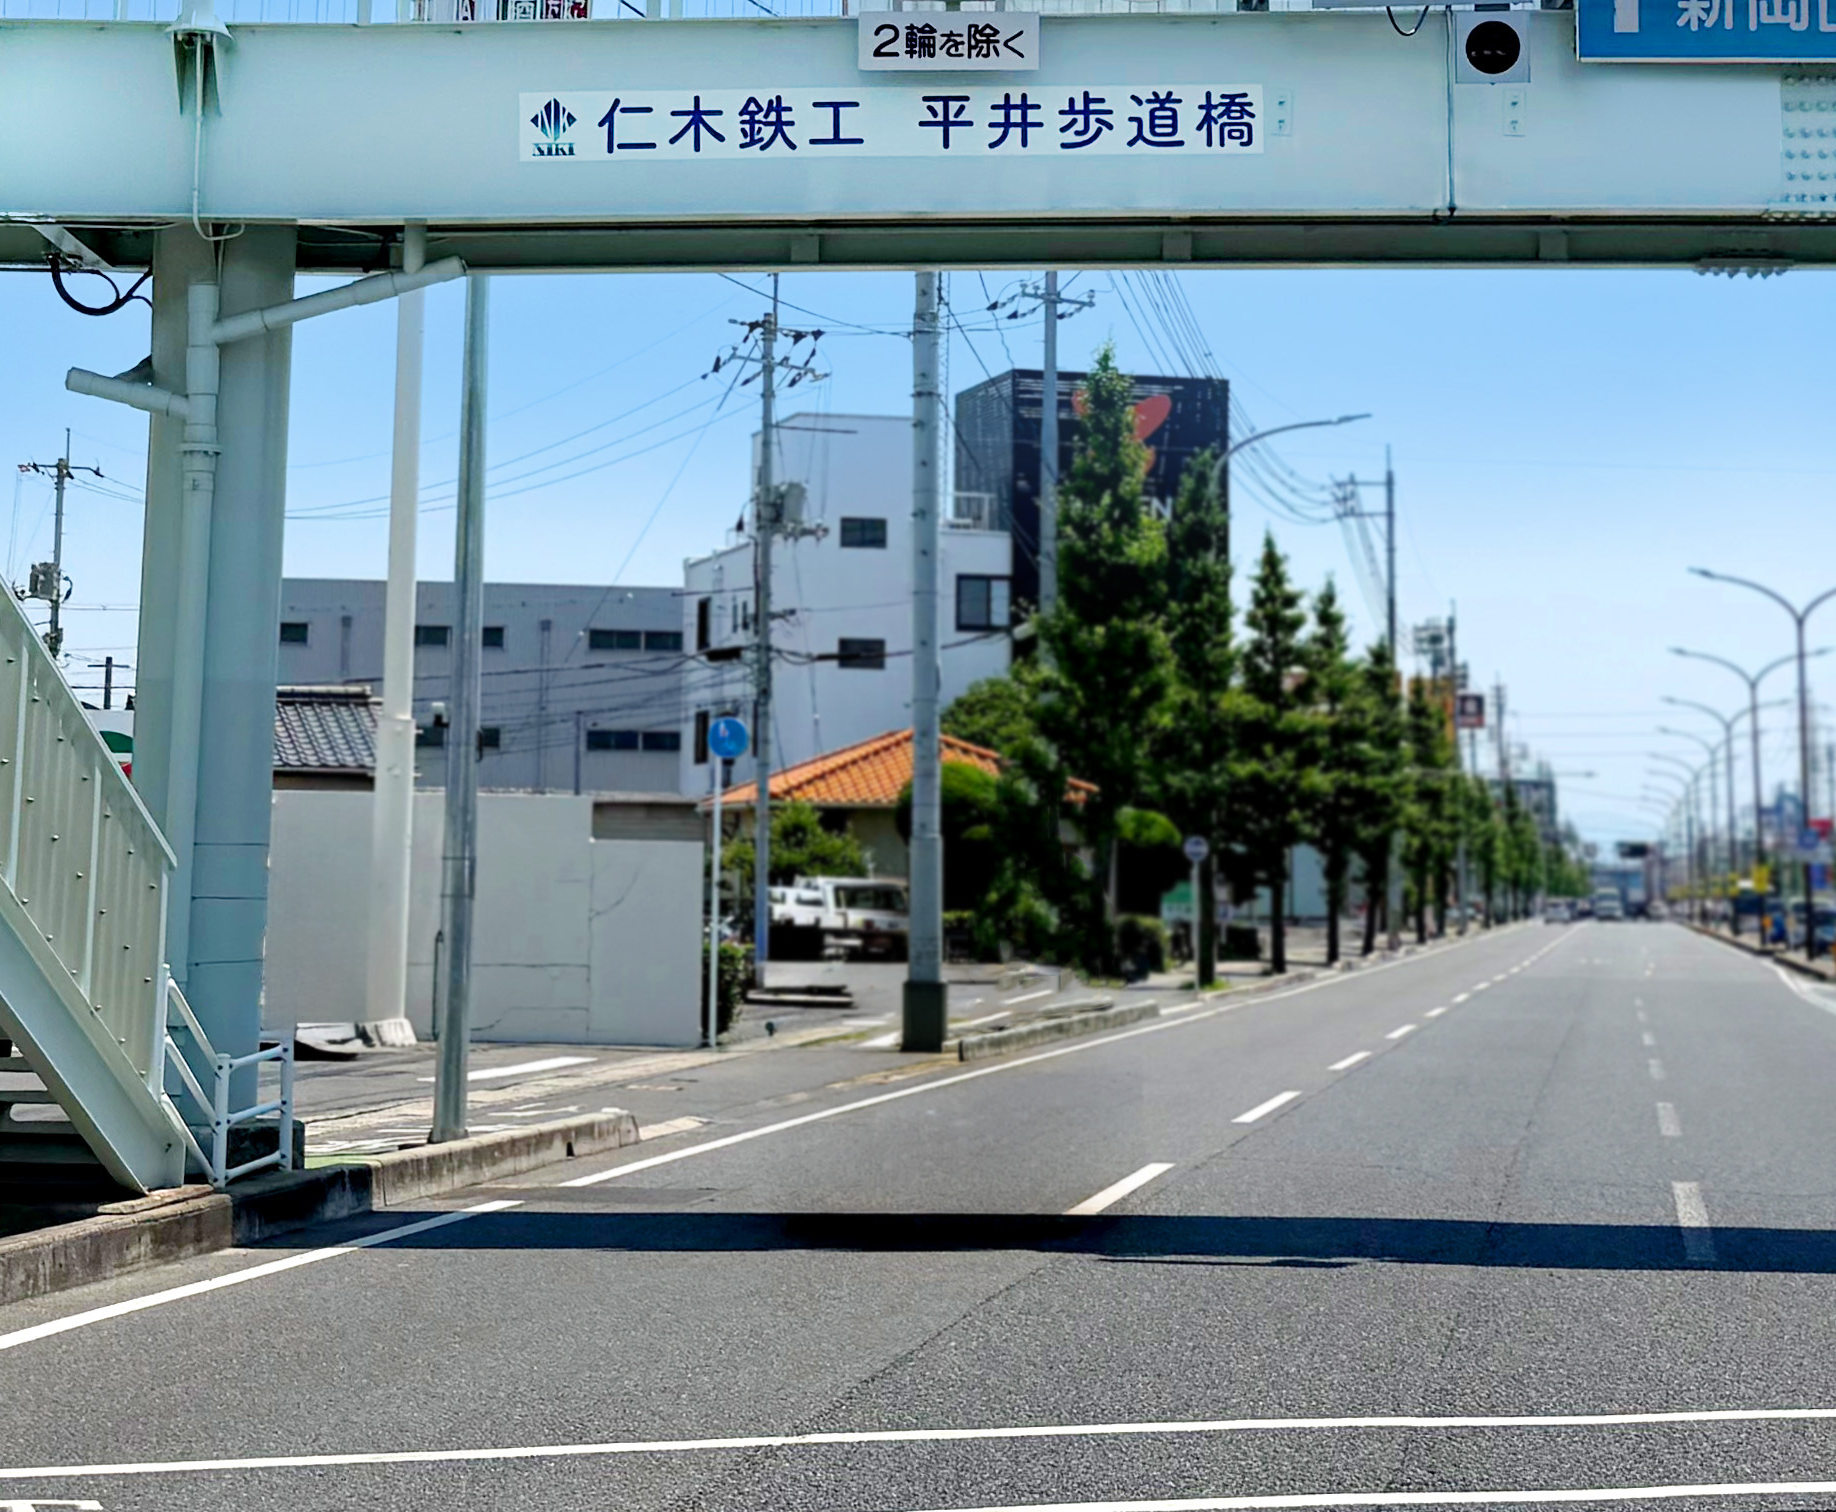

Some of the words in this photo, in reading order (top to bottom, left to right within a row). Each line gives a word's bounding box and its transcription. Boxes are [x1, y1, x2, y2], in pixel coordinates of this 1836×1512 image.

[872, 23, 1026, 60] 2輪を除く
[598, 94, 865, 154] 仁木鉄工
[918, 90, 1257, 150] 平井歩道橋
